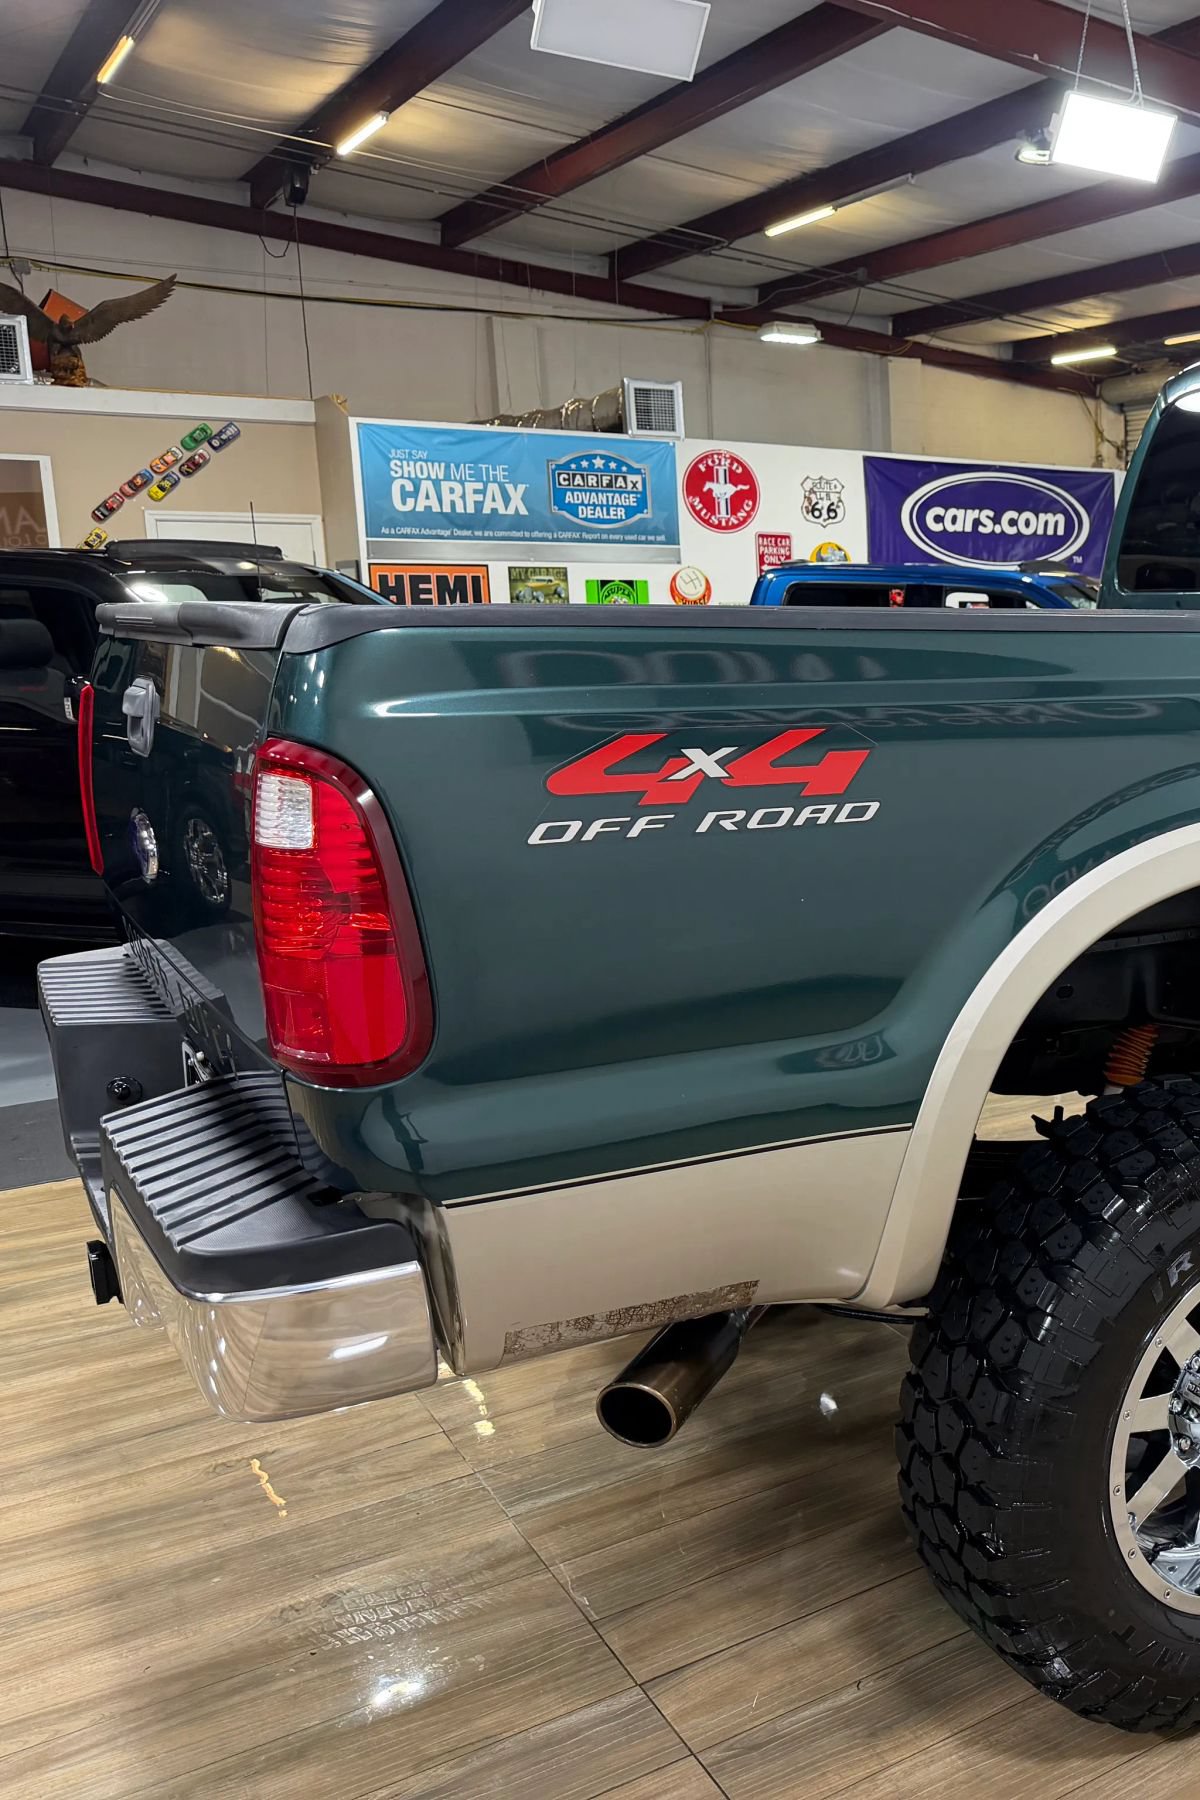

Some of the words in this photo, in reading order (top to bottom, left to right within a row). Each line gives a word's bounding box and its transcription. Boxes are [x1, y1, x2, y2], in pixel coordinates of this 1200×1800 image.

[389, 450, 409, 459] JUST
[411, 450, 428, 460] SAY
[390, 460, 445, 480] SHOW
[451, 464, 475, 481] ME
[479, 464, 510, 482] THE
[698, 452, 743, 475] FORD
[559, 474, 639, 490] CARFAX
[392, 479, 529, 516] CARFAX
[565, 491, 638, 507] ADVANTAGE
[578, 506, 626, 520] DEALER
[688, 495, 753, 527] MUSTANG
[811, 501, 838, 520] 66
[925, 506, 1065, 536] cars.com
[396, 527, 420, 535] CARFAX
[494, 529, 523, 537] committed
[531, 531, 552, 539] offering
[582, 532, 600, 541] Report
[759, 537, 775, 546] RACE
[777, 537, 791, 546] CAR
[760, 546, 791, 556] PARKING
[764, 555, 785, 564] ONLY
[511, 568, 526, 579] MY
[527, 568, 566, 580] GARAGE
[378, 574, 482, 605] HEMI
[527, 815, 675, 844] OFF
[695, 801, 881, 833] ROAD
